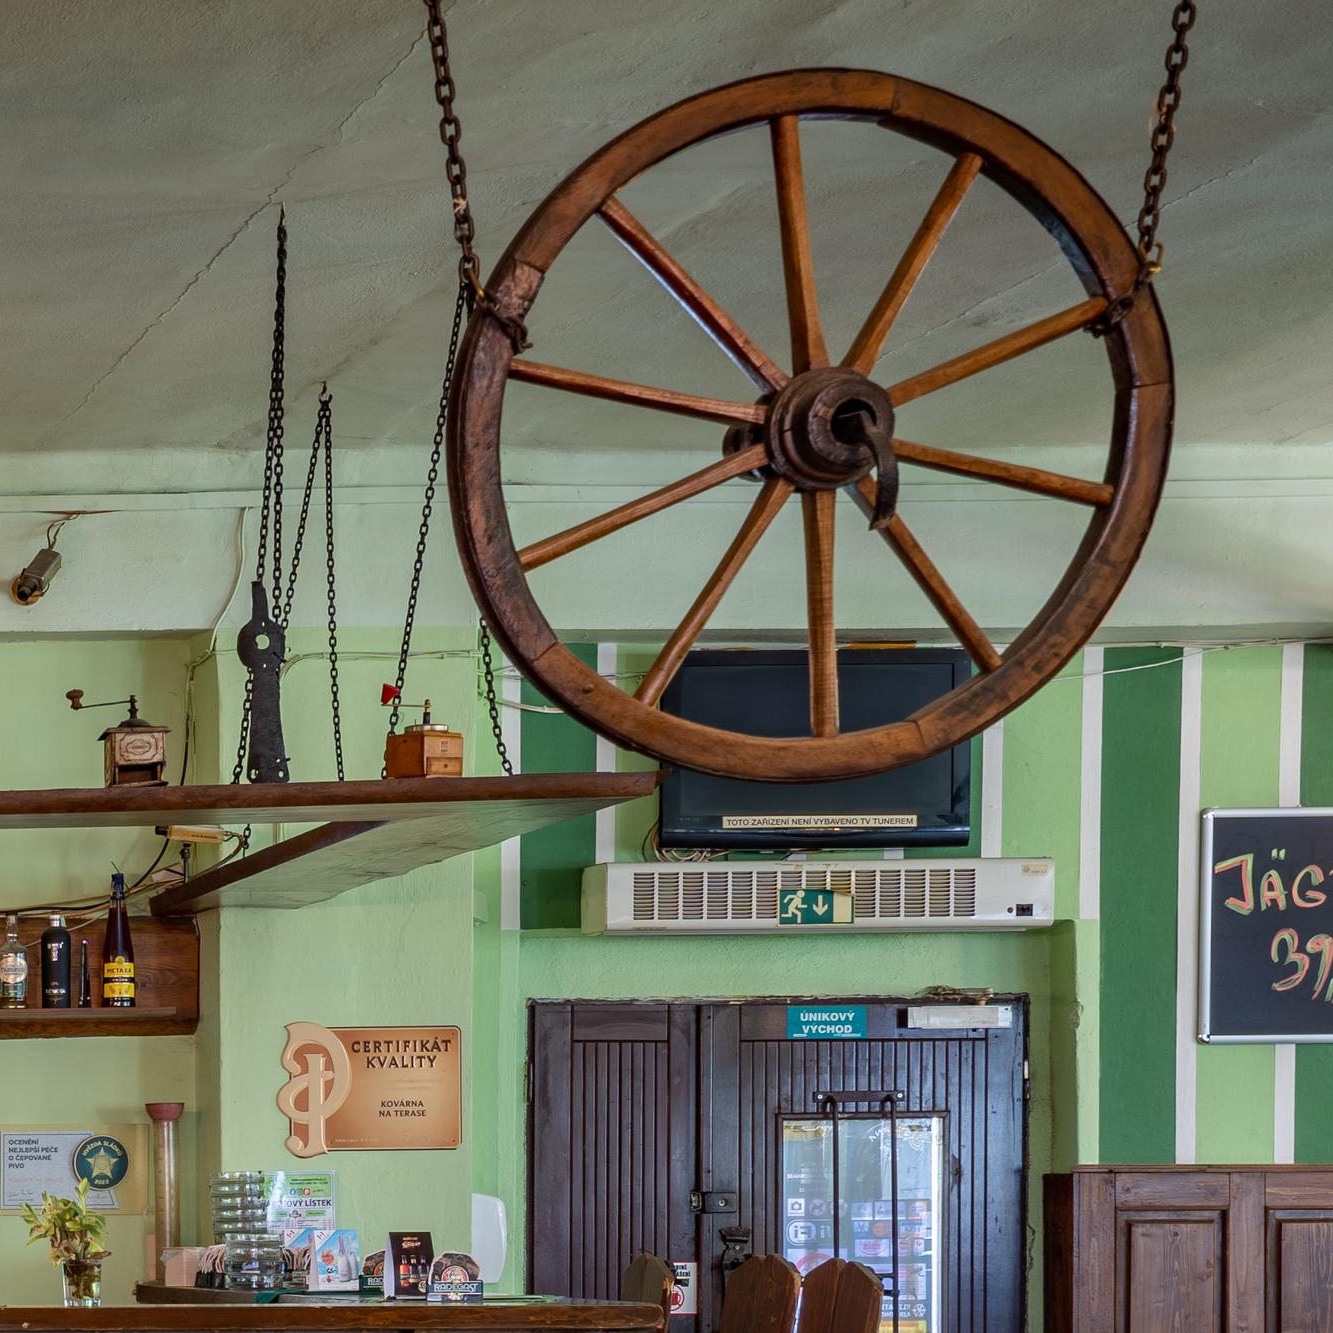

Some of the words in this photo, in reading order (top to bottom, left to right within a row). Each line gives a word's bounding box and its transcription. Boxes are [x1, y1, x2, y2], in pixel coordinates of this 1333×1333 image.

[726, 818, 749, 826] TOTO
[751, 817, 790, 826] ZAŘÍZENÍ
[791, 816, 812, 825] NENÍ
[813, 817, 859, 825] VYBAVENO
[861, 817, 871, 825] TV
[872, 817, 914, 825] TUNEREM
[1214, 848, 1333, 916] JÄG
[106, 966, 132, 974] METAXA
[800, 1009, 855, 1022] ÚNIKOVÝ
[802, 1022, 852, 1034] VÝCHOD
[351, 1037, 452, 1053] CERTIFIKÁT
[366, 1055, 437, 1069] KVALITY
[381, 1098, 424, 1108] KOVÁRNA
[15, 1153, 52, 1161] ČEPOVANÉ
[304, 1197, 332, 1207] LÍSTEK
